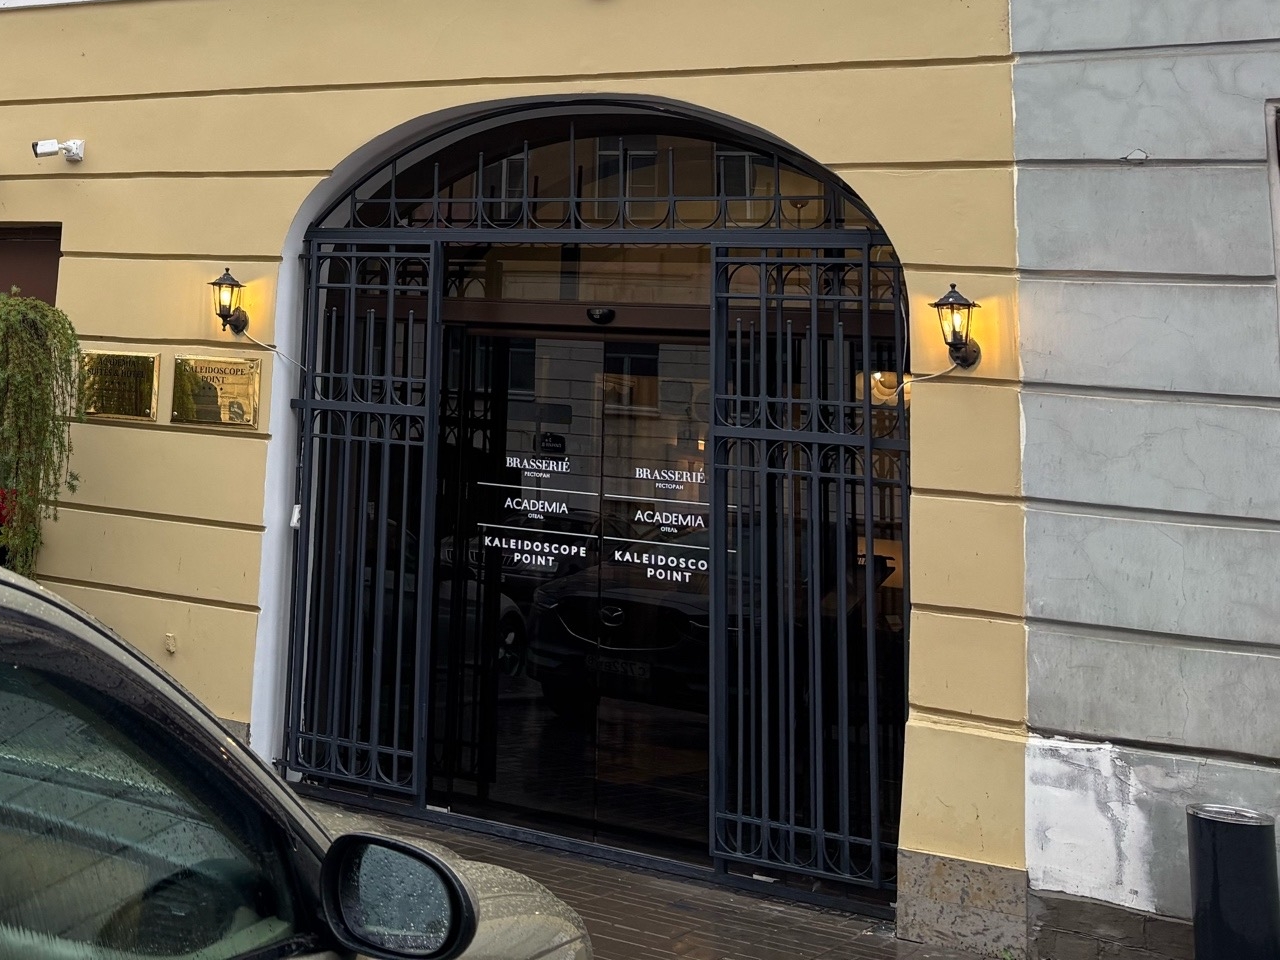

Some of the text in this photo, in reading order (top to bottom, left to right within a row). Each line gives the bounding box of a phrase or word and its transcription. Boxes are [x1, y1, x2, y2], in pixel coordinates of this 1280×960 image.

[183, 363, 246, 376] KALEIDOSCOPE
[201, 376, 226, 384] POINT
[505, 457, 570, 473] BRASSERIÉ
[635, 467, 706, 483] BRASSERIÉ
[655, 482, 684, 490] РЕСТОРАН
[504, 497, 569, 515] ACADEMIA
[634, 510, 705, 528] ACADEMIA
[484, 536, 587, 557] KALEIDOSCOPE
[513, 553, 555, 567] POINT
[614, 550, 708, 571] KALEIDOSCO
[647, 568, 692, 583] POINT
